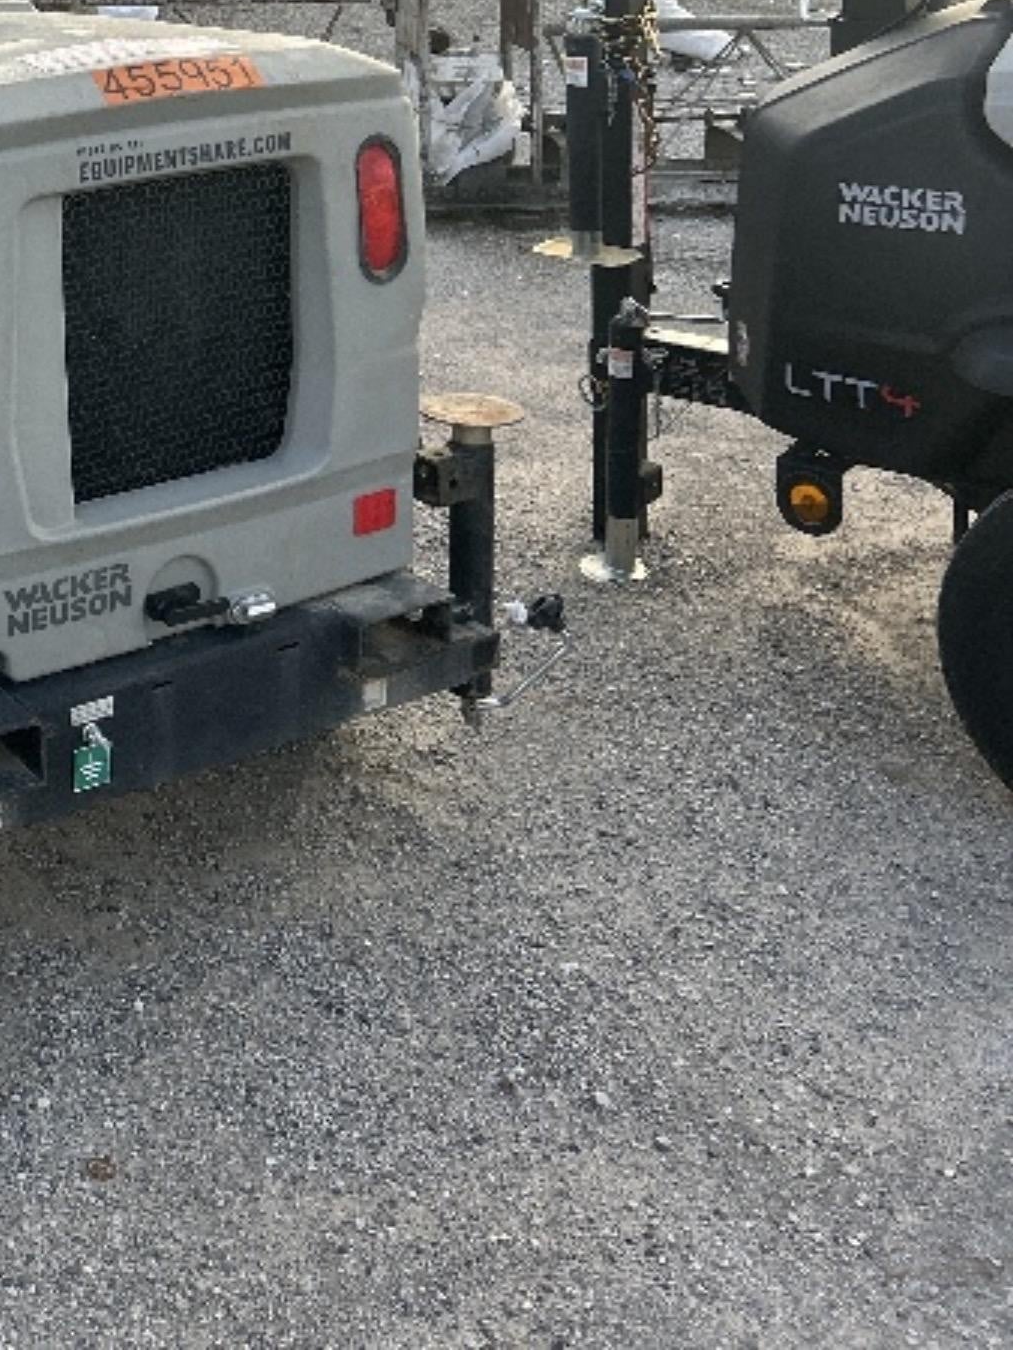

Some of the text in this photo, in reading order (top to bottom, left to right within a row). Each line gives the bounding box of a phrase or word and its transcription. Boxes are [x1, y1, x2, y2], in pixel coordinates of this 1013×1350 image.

[102, 57, 256, 100] 455951
[78, 131, 292, 184] EQUIPMENTSHARE.COM
[838, 182, 966, 213] WACKER
[838, 203, 967, 236] NEUSON
[784, 361, 922, 419] LTT4
[3, 563, 132, 612] WACKER
[6, 585, 133, 638] NEUSON
